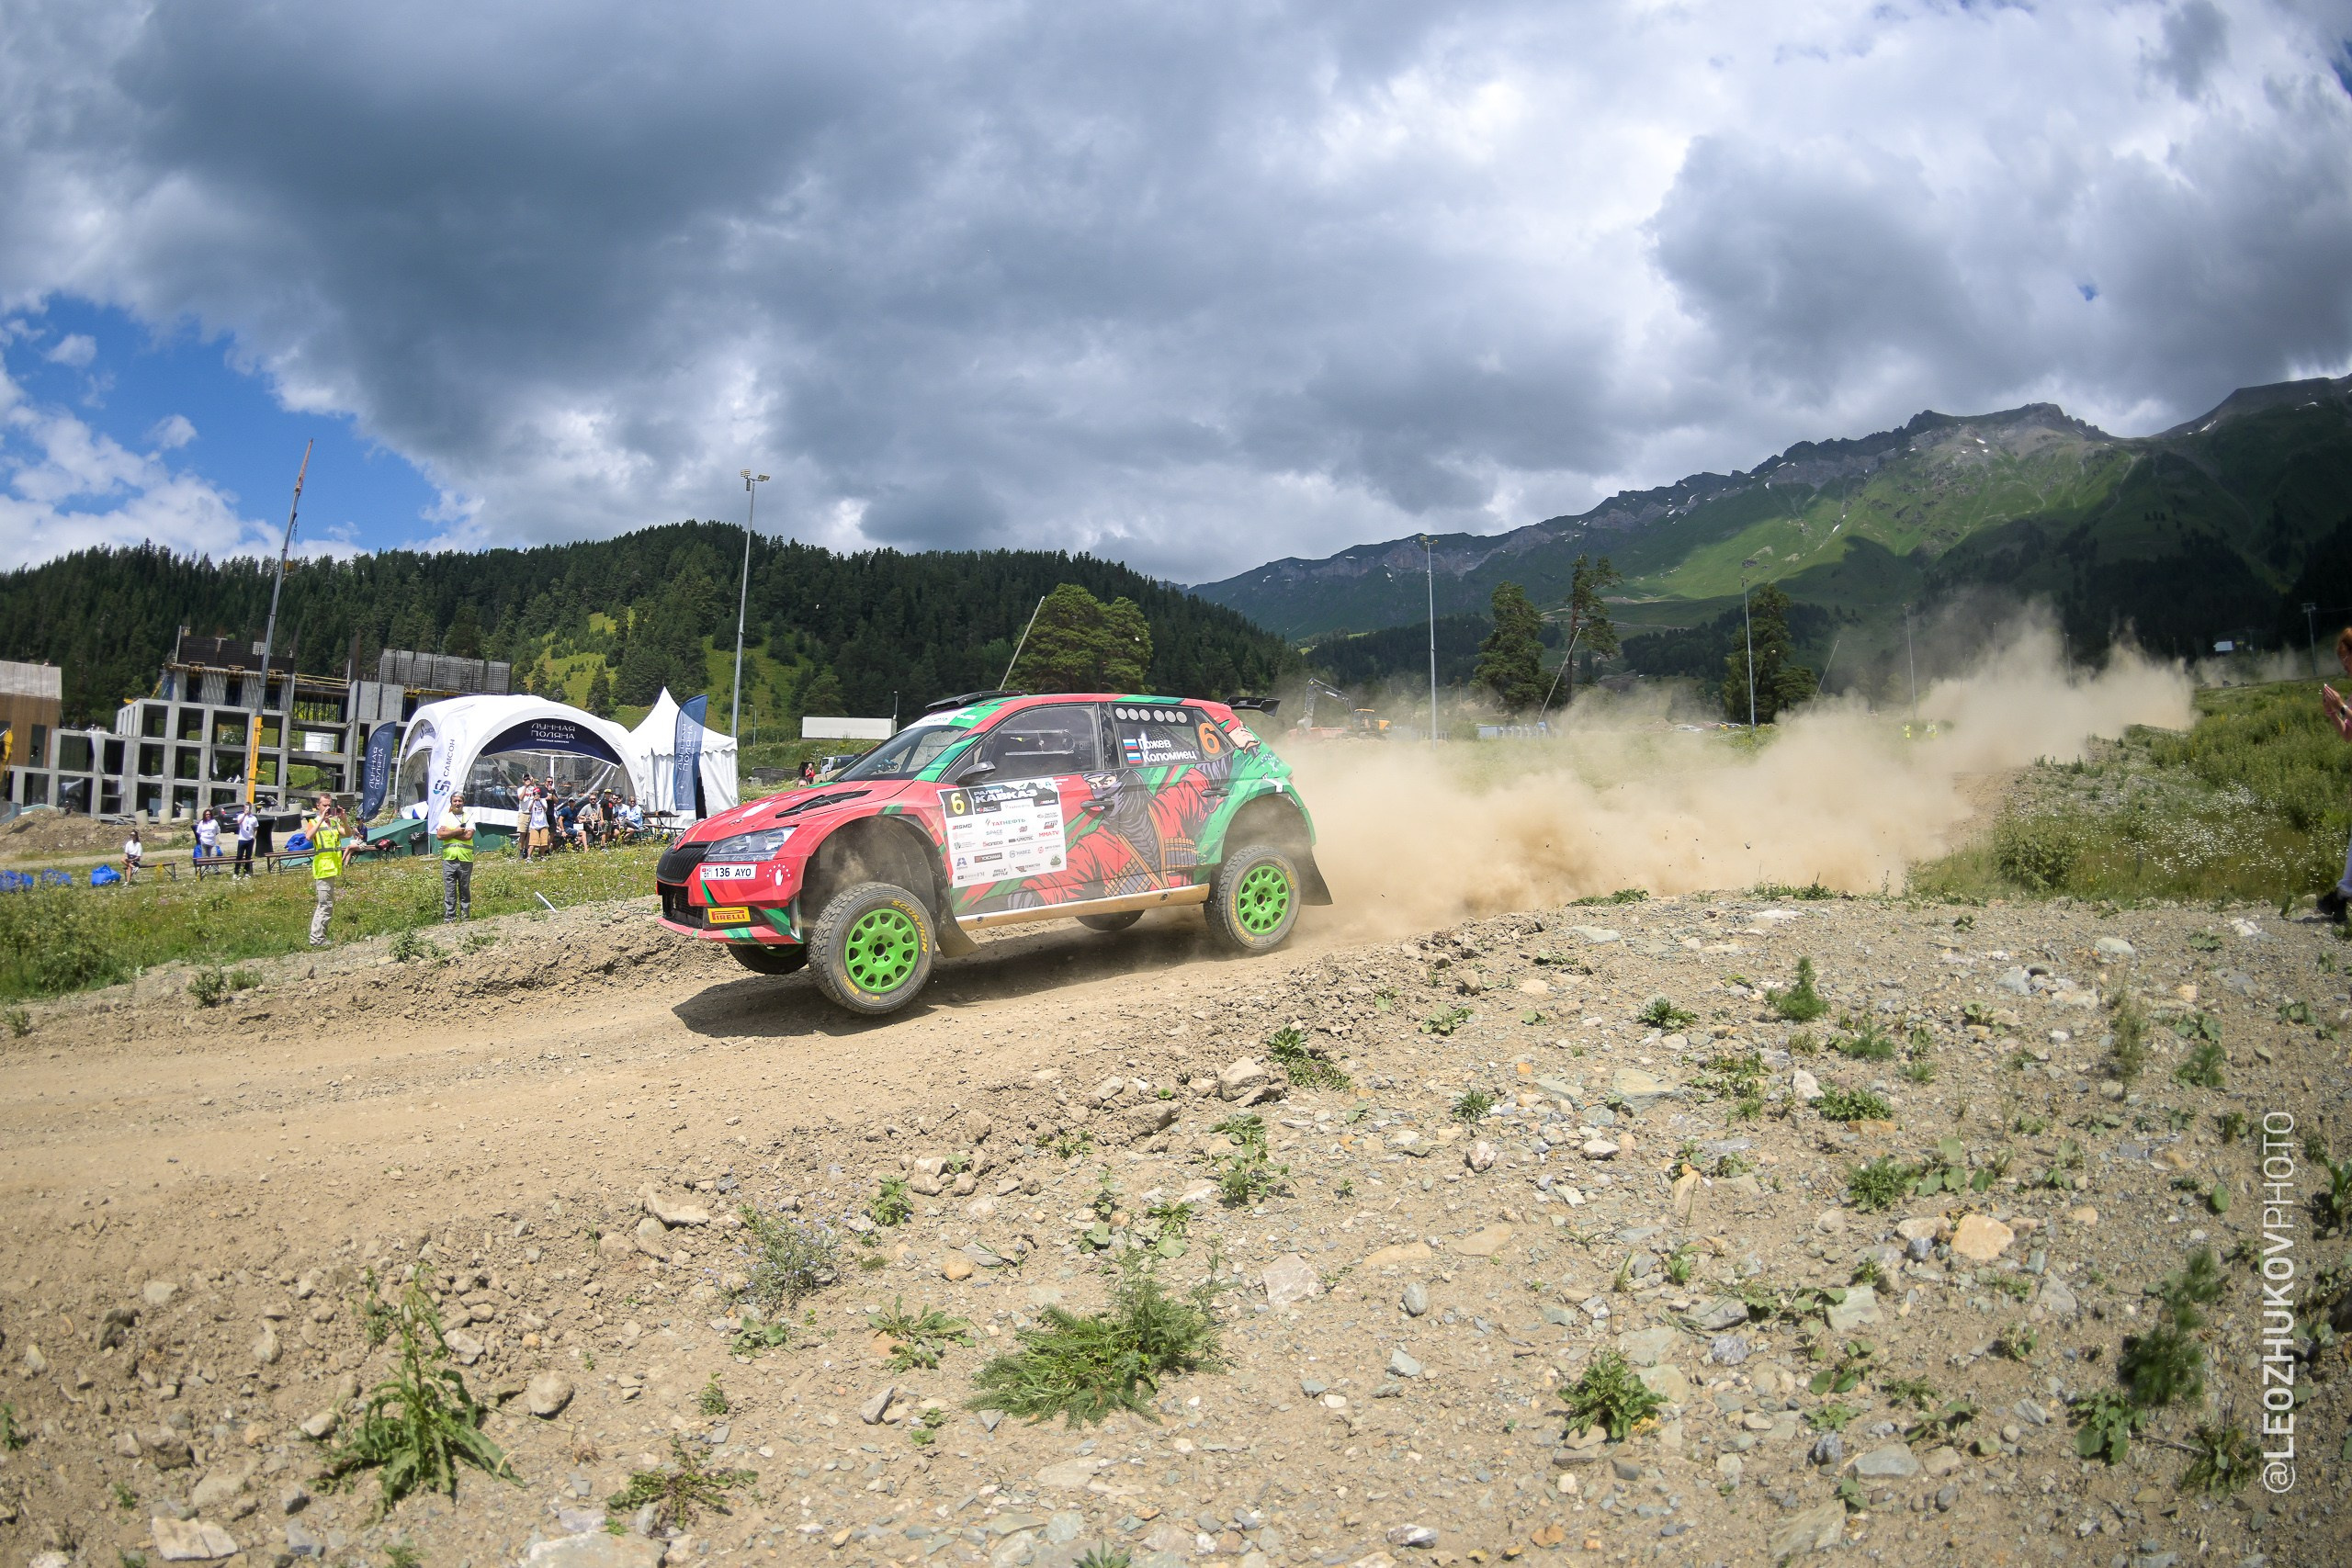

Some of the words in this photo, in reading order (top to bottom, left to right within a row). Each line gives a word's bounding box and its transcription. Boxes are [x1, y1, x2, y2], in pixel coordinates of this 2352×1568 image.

[531, 722, 576, 732] ЛУННАЯ
[531, 729, 575, 739] ПОЛЯНА
[1198, 722, 1221, 754] 6
[683, 724, 694, 772] ПОЛЯНА
[1141, 750, 1197, 762] Коломиец
[443, 739, 456, 777] САМСОН
[369, 746, 379, 790] ЛУННАЯ
[374, 748, 384, 790] ПОЛЯНА
[974, 788, 1003, 796] РАЛЛИ
[974, 789, 1038, 804] КАВКАЗ
[950, 792, 966, 815] 6
[991, 818, 1026, 827] ТАТНЕФТЬ
[715, 867, 730, 877] 136
[735, 868, 752, 877] AYO
[711, 909, 746, 920] PIRELLI
[1231, 893, 1255, 942] SCORPION
[890, 899, 928, 953] SCORPION
